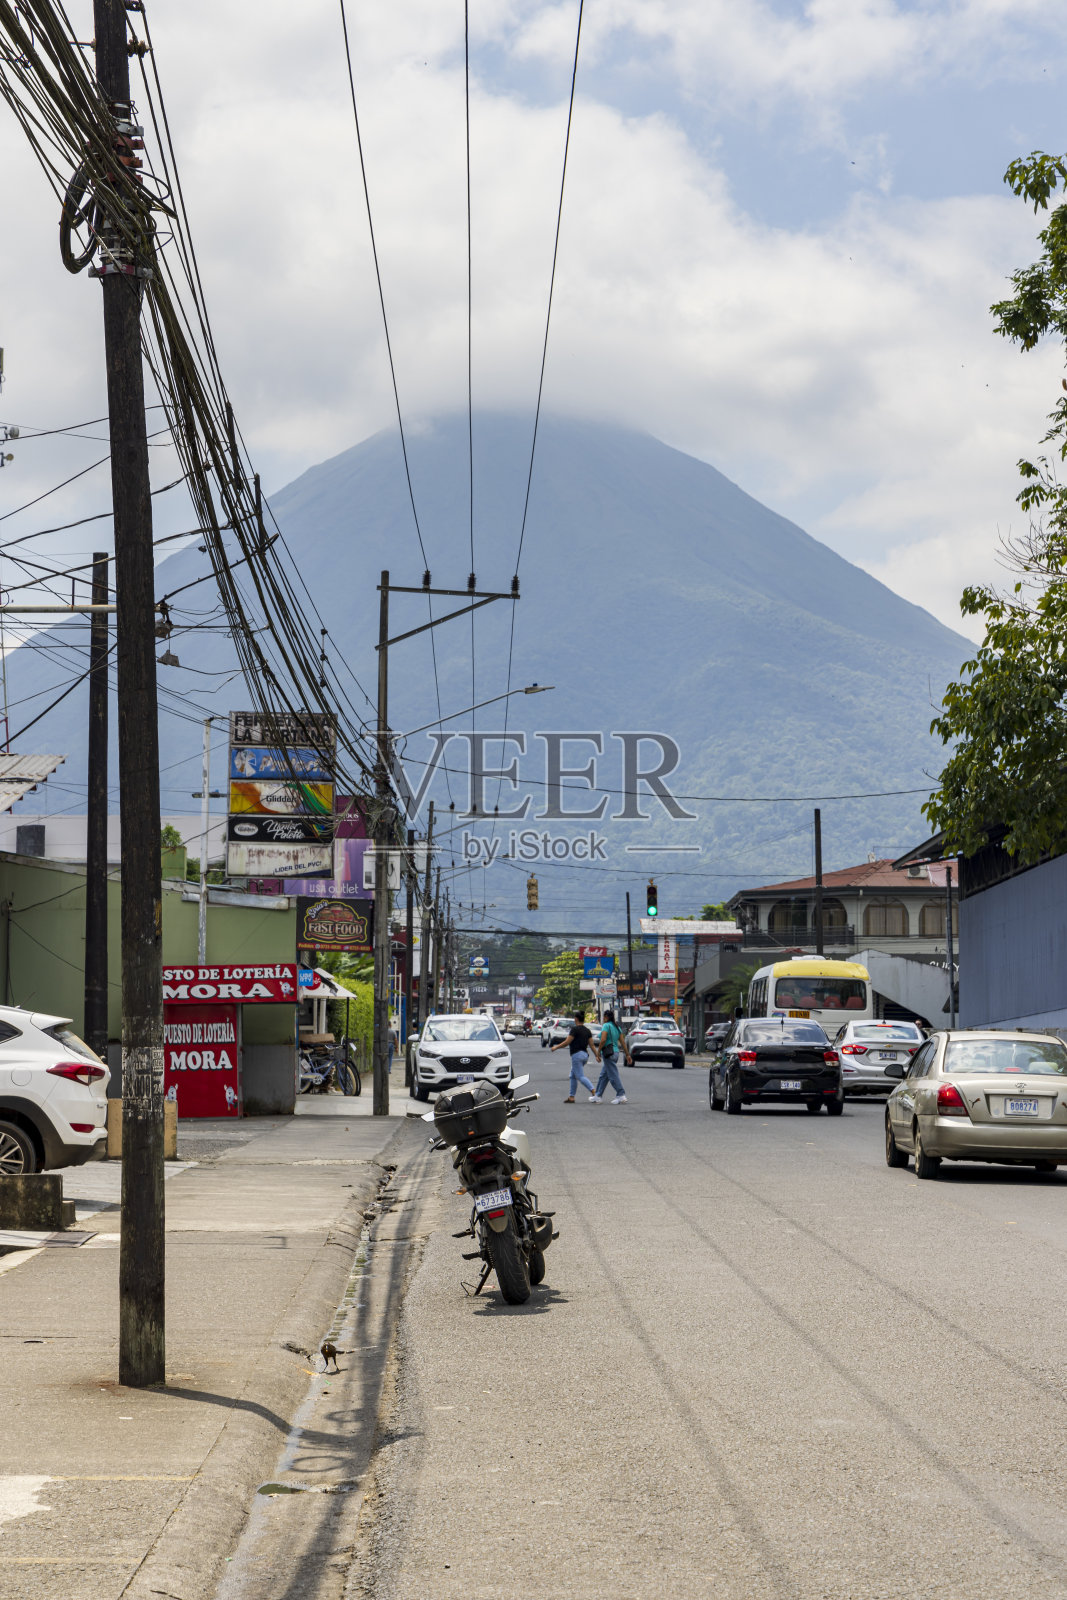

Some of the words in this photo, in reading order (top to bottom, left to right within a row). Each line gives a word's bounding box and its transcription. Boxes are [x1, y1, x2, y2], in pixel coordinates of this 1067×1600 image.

[235, 715, 331, 727] FEETERIA
[235, 728, 252, 742] LA
[309, 883, 327, 893] USA
[328, 882, 359, 894] outlet
[334, 924, 363, 935] FOOD
[162, 969, 195, 981] STO
[198, 968, 220, 980] DE
[223, 965, 293, 979] LOTERÍA
[163, 983, 274, 999] MORA
[163, 1023, 192, 1044] PUESTO
[192, 1023, 203, 1044] DE
[203, 1017, 236, 1044] LOTERÍA
[170, 1050, 233, 1070] MORA
